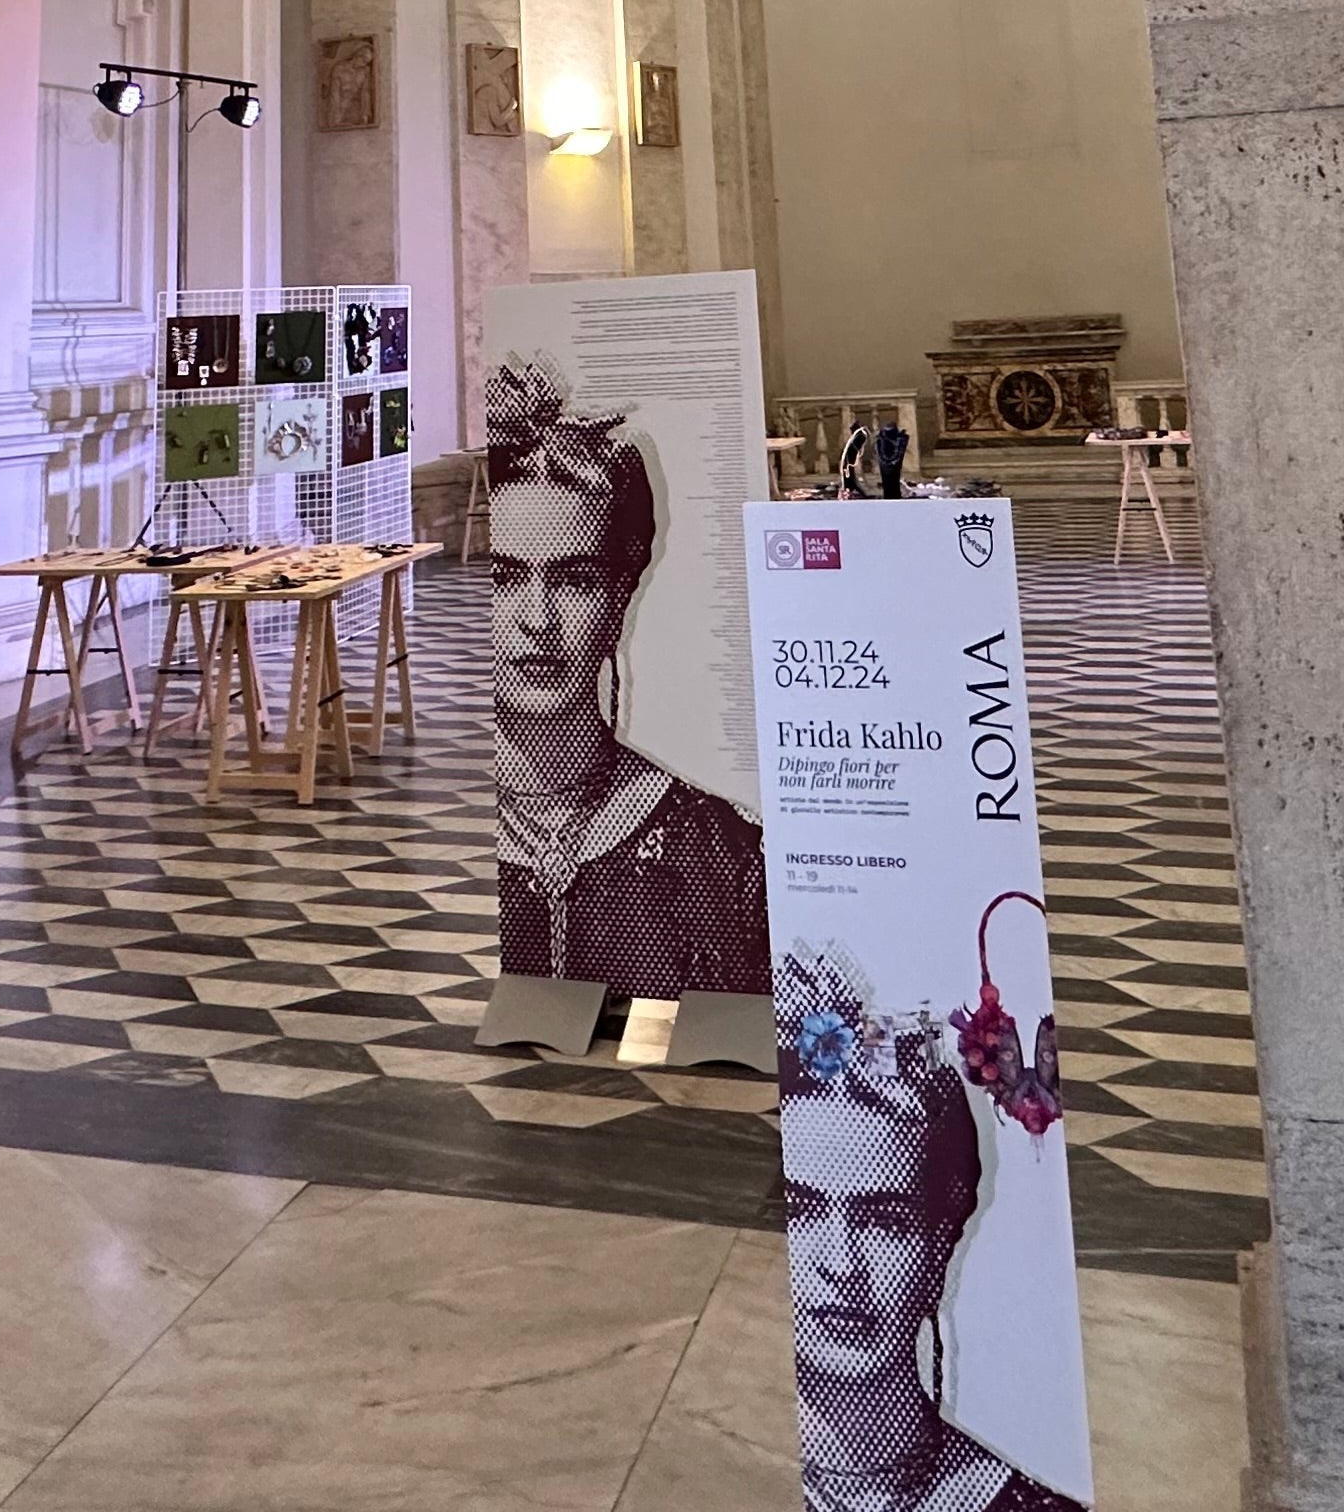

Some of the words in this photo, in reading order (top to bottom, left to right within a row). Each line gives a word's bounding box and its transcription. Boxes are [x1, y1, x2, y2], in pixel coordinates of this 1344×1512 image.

[805, 538, 829, 546] SALA
[806, 545, 836, 554] SANTA
[806, 553, 828, 561] RITA
[773, 640, 879, 664] 30.11.24
[776, 665, 890, 688] 04.12.24
[963, 629, 1021, 822] ROMA
[777, 720, 851, 748] Frida
[861, 722, 942, 750] Kahlo
[778, 757, 835, 775] Dipingo
[838, 758, 870, 777] fiori
[875, 760, 900, 777] per
[779, 773, 806, 787] non
[811, 772, 842, 790] farli
[847, 775, 895, 790] morire
[786, 854, 853, 866] INGRESSO
[857, 857, 906, 868] LIBERO
[786, 870, 795, 880] 11
[806, 871, 818, 882] 19
